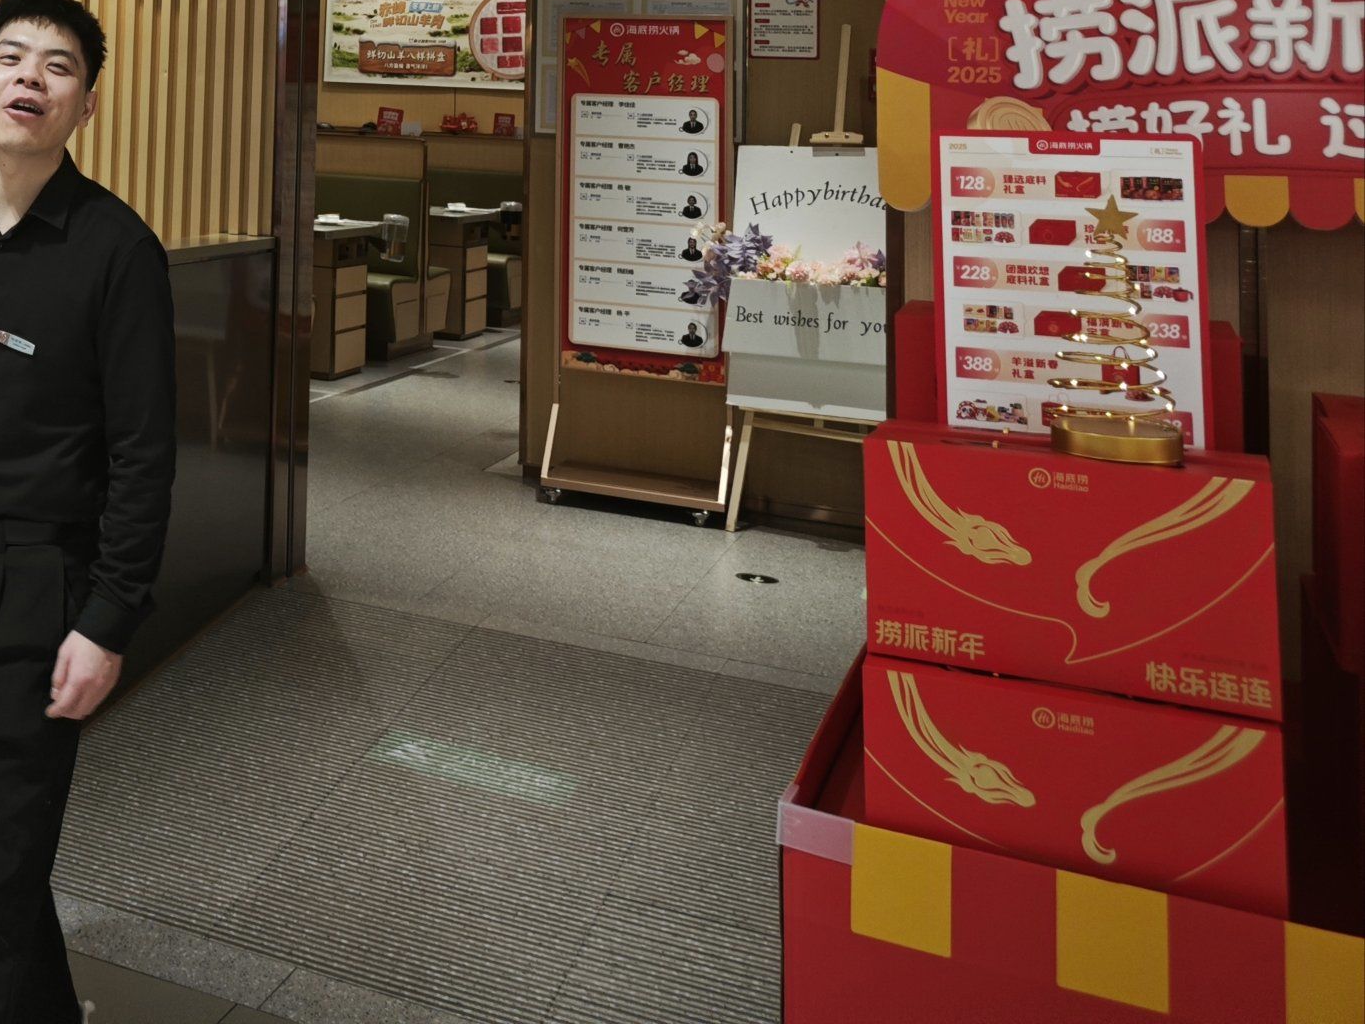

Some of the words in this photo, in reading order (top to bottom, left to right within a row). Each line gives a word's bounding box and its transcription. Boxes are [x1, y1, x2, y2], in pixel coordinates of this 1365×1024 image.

[944, 9, 989, 24] Year
[626, 24, 680, 36] 海底捞火锅
[591, 40, 637, 67] 专属
[622, 70, 712, 94] 客户经理
[947, 66, 1002, 84] 2025
[949, 143, 968, 151] 2025
[1049, 141, 1094, 151] 海底捞火锅
[1003, 184, 1025, 195] 礼盒
[1005, 275, 1050, 287] 底料礼盒
[735, 304, 764, 324] Best
[774, 309, 820, 329] wishes
[824, 311, 848, 333] for
[1011, 369, 1035, 380] 礼盒
[1053, 471, 1089, 485] 海底捞
[1053, 482, 1090, 493] Haidilao
[875, 618, 986, 661] 捞派新年
[1145, 661, 1273, 709] 快乐连连
[1057, 712, 1095, 728] 海底捞
[1057, 723, 1095, 736] Haidilao
